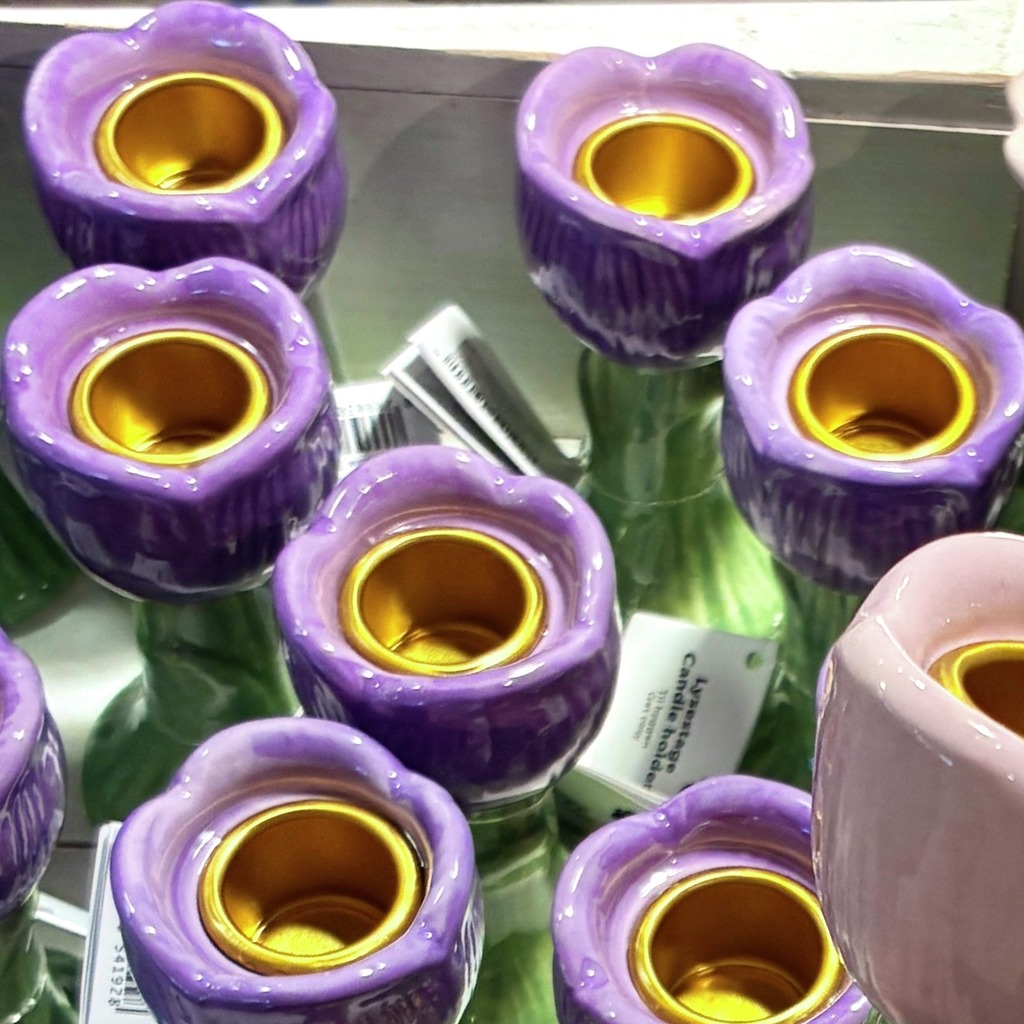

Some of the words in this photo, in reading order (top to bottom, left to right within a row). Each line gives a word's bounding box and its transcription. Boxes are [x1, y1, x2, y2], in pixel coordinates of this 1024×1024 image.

[668, 652, 696, 724] Candle
[643, 725, 675, 789] holder
[666, 676, 708, 774] Lysestage
